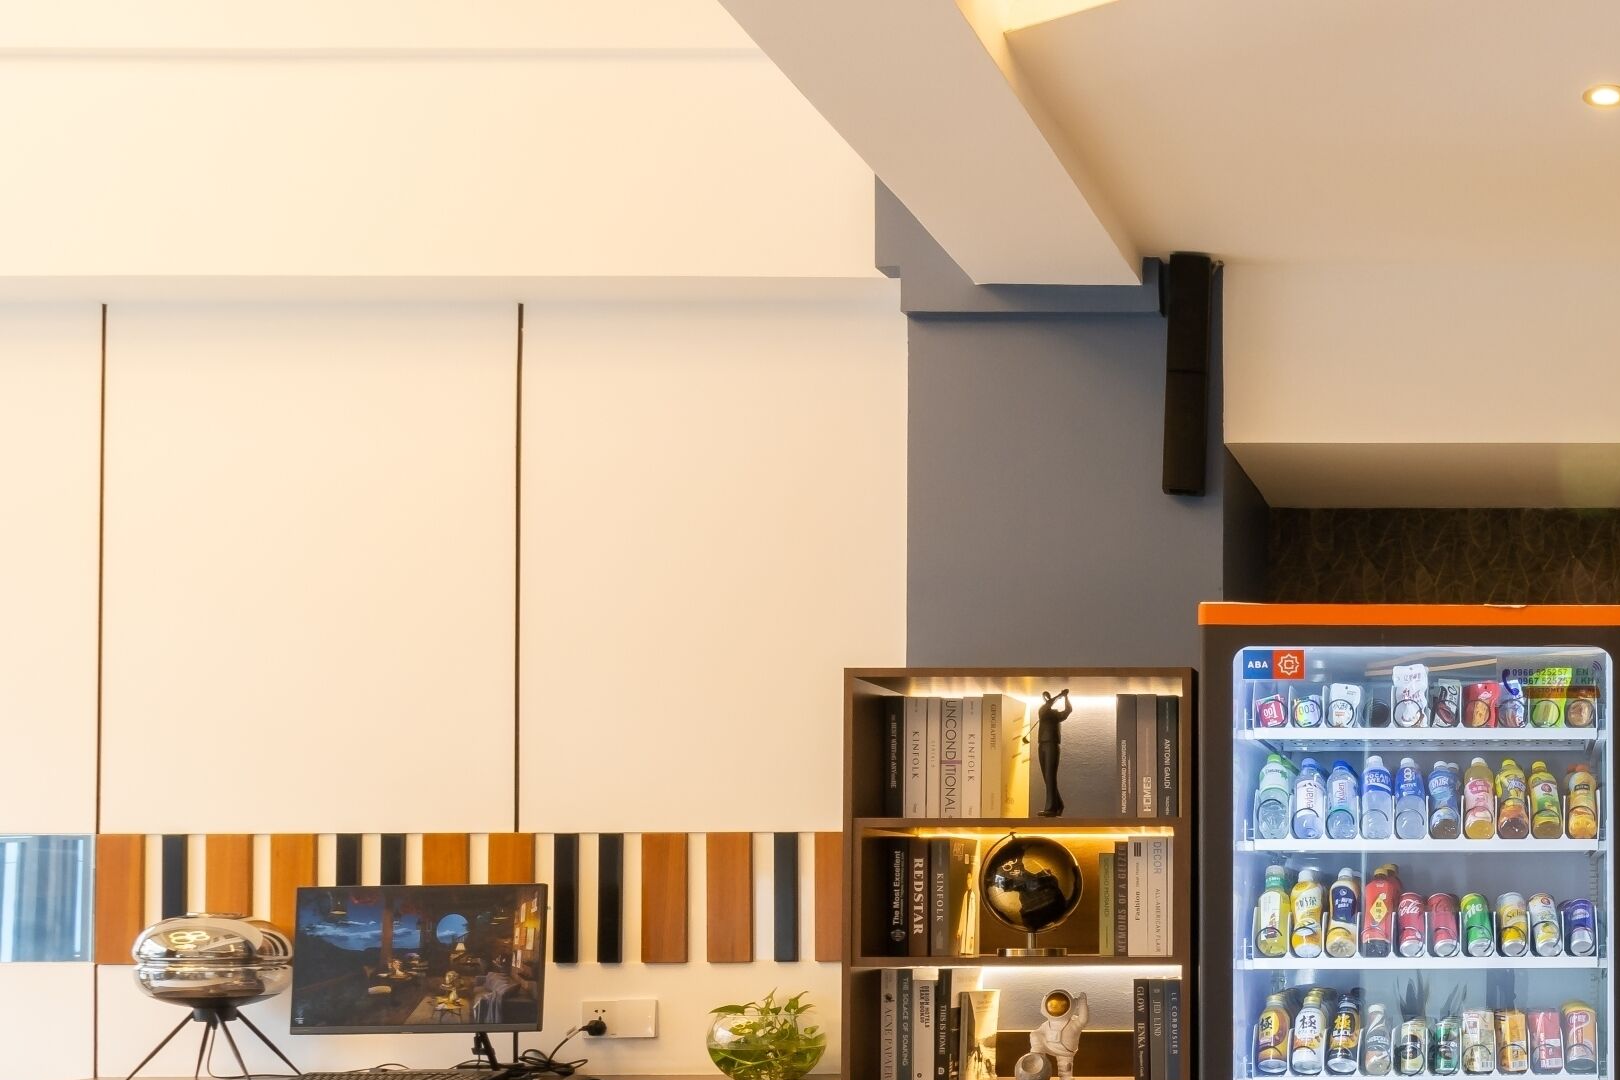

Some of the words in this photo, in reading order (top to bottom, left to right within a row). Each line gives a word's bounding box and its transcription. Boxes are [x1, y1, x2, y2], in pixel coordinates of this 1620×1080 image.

[1248, 660, 1268, 668] ABA
[1143, 777, 1152, 811] HOMES
[1153, 842, 1161, 874] DECOR
[914, 858, 924, 934] REDSTAR
[1119, 895, 1126, 904] OF
[1172, 992, 1177, 1001] LE
[903, 1022, 908, 1031] OF
[1153, 1018, 1161, 1036] LIND
